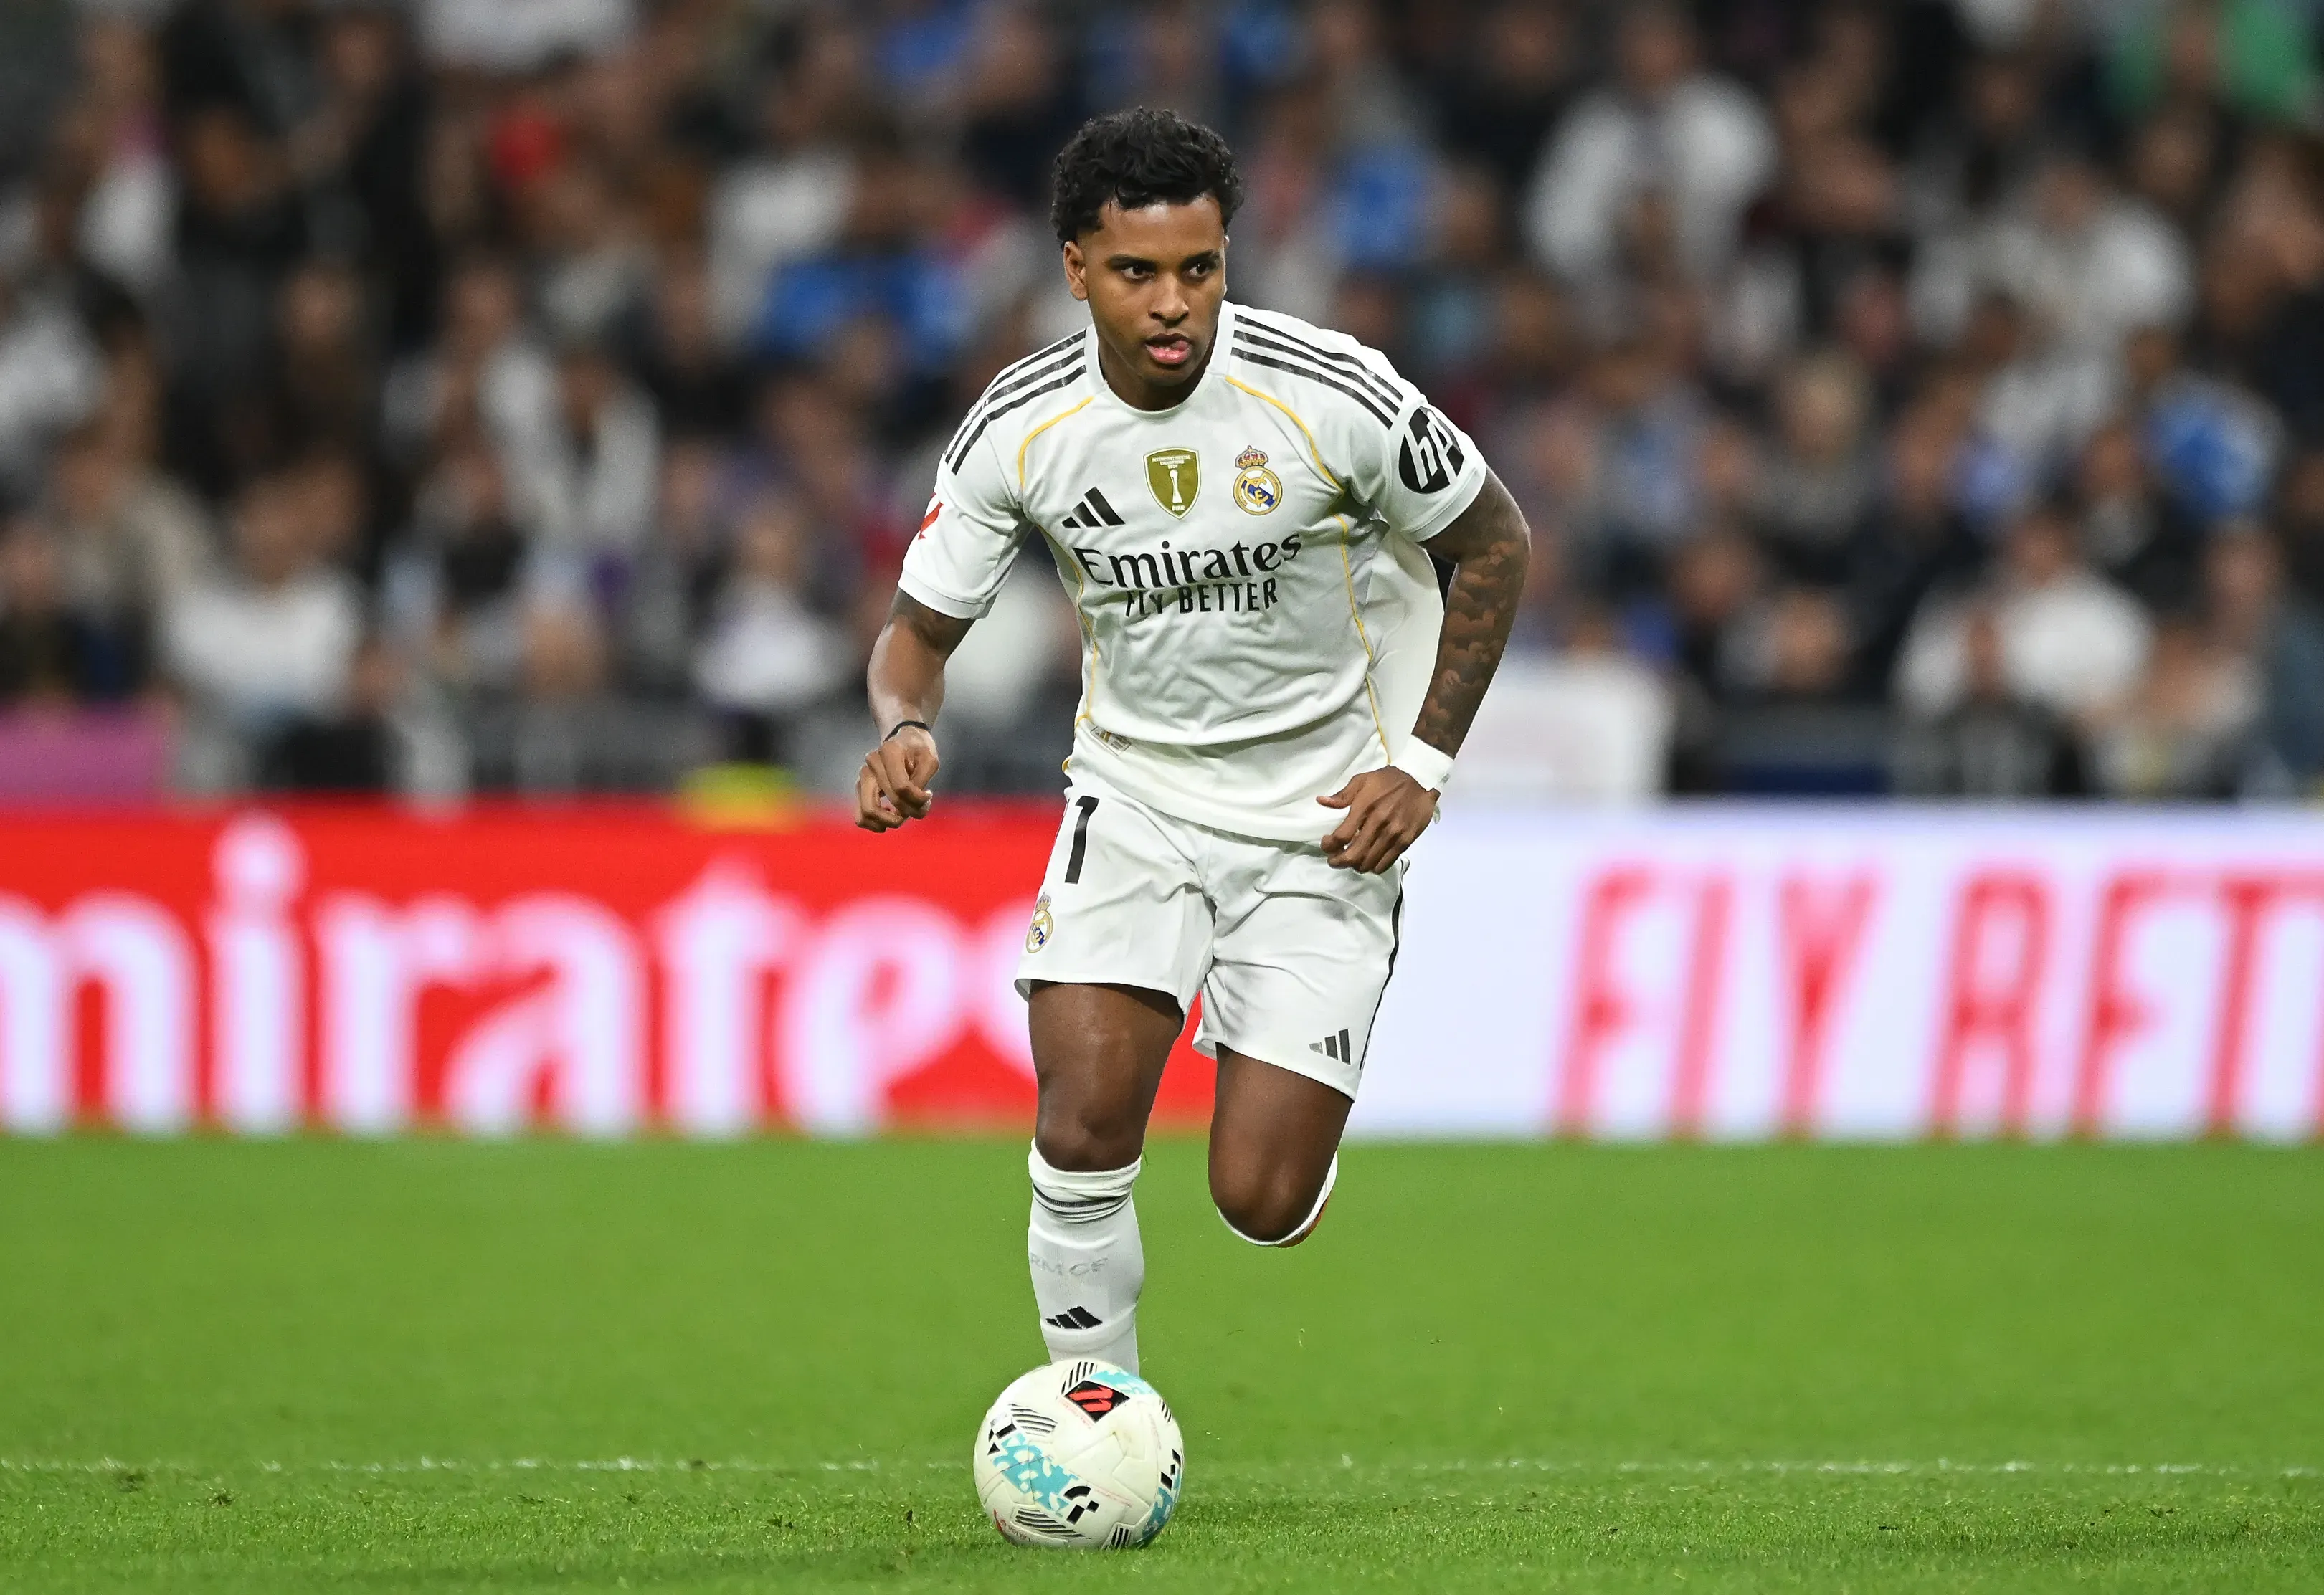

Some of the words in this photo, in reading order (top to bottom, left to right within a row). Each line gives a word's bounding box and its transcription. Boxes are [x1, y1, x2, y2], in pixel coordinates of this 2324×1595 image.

[1401, 409, 1461, 490] hp
[1071, 533, 1301, 589] Emirates
[1177, 577, 1279, 614] BETTER
[1063, 795, 1100, 885] 1
